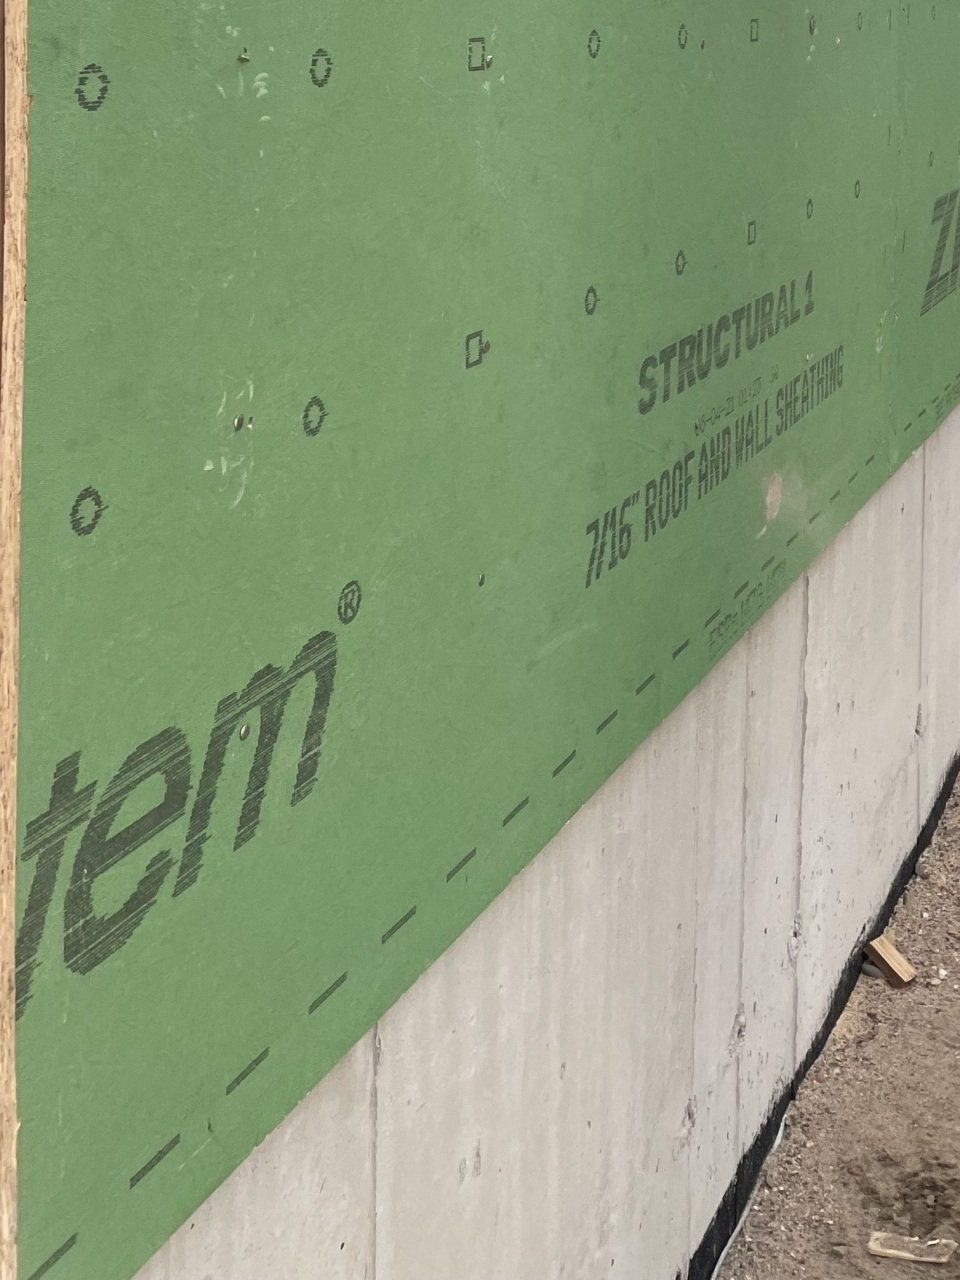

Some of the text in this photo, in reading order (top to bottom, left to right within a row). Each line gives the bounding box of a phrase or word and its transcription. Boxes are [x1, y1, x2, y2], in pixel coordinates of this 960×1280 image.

[638, 270, 815, 415] STRUCTURAL 1
[645, 450, 696, 542] ROOF
[698, 425, 732, 500] AND
[735, 398, 773, 470] WALL
[776, 344, 844, 438] SHEATHING
